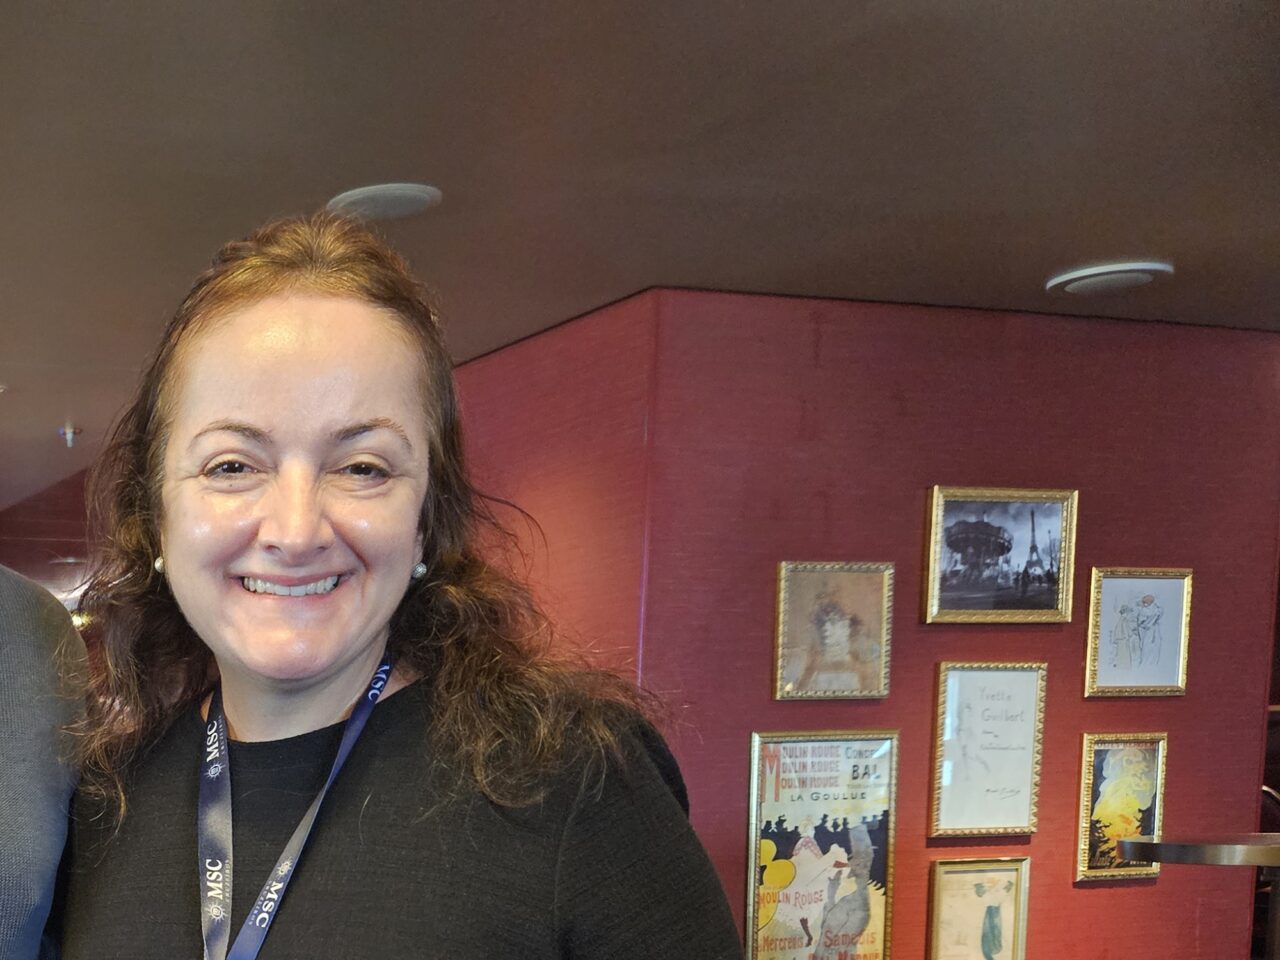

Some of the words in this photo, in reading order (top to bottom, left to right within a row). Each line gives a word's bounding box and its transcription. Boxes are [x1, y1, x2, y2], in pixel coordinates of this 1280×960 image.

[368, 665, 390, 700] MSC
[206, 721, 219, 762] MSC
[851, 764, 881, 780] BAL
[791, 794, 804, 802] LA
[206, 859, 222, 900] MSC
[256, 881, 284, 927] MSC
